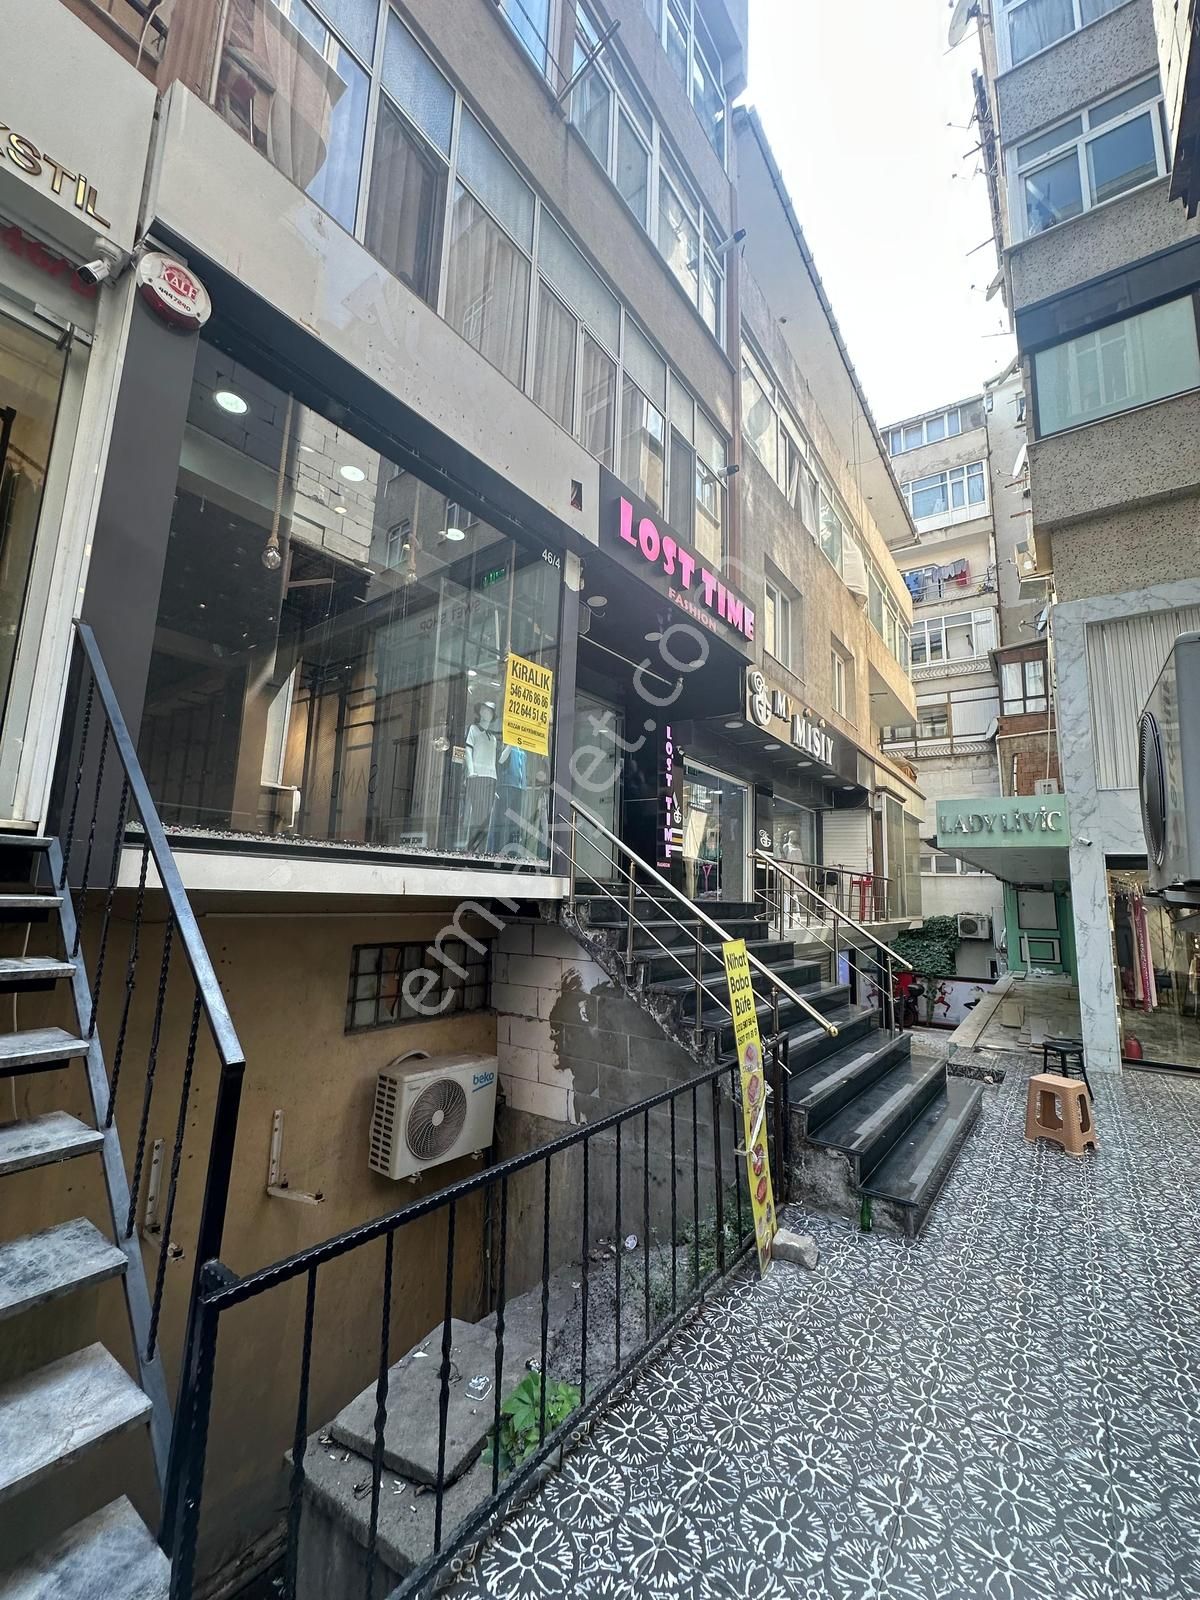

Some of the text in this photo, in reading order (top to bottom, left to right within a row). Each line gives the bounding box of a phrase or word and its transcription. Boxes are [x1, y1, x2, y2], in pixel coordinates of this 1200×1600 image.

[160, 264, 198, 301] KALE
[541, 548, 561, 570] 46/4
[617, 495, 755, 641] LOST TIME
[668, 586, 717, 632] FASHION
[510, 683, 522, 698] 546
[522, 688, 533, 703] 476
[772, 690, 793, 722] MY
[508, 699, 520, 715] 212
[532, 707, 539, 722] 51
[665, 725, 673, 787] LOST
[664, 796, 673, 858] TIME
[940, 813, 998, 834] LADY
[726, 952, 747, 972] Nihat
[472, 1072, 494, 1085] beko
